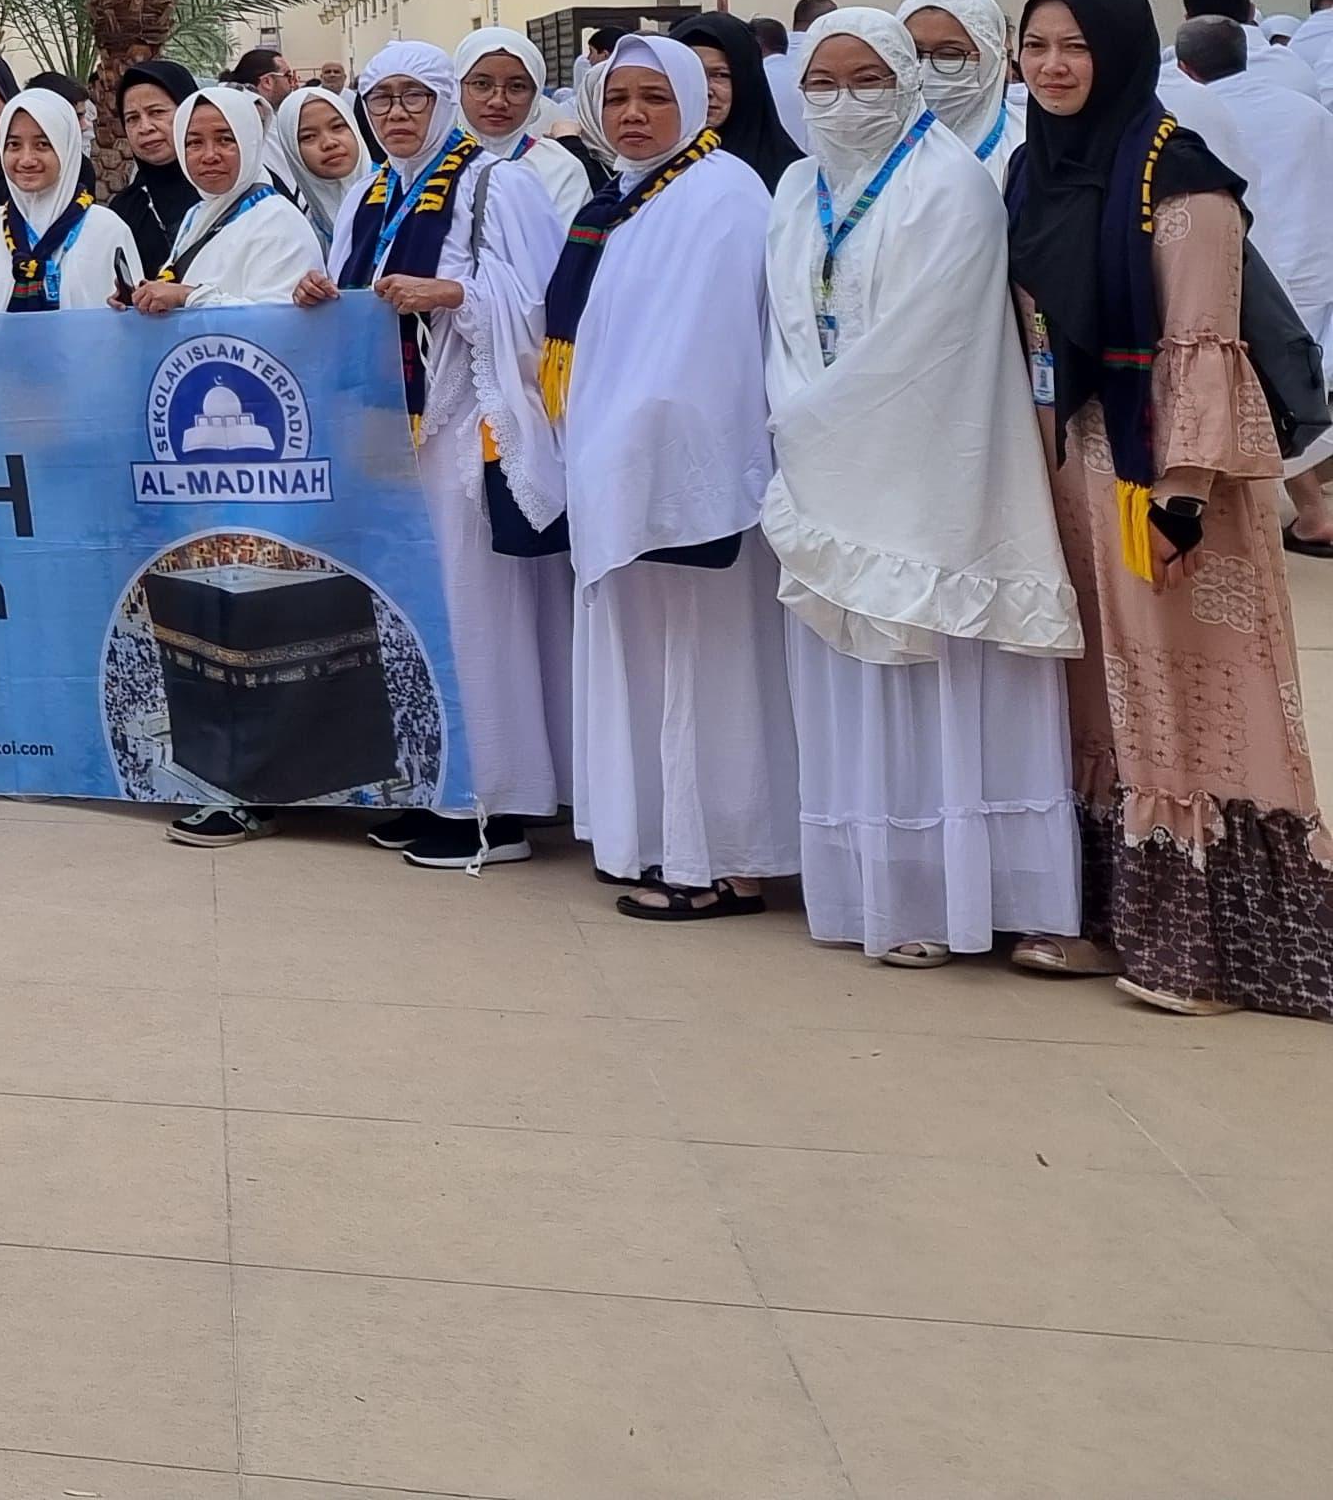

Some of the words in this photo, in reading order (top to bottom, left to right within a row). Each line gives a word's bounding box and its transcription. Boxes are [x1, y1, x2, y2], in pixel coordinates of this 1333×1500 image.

[152, 357, 187, 453] SEKOLAH
[187, 343, 244, 364] ISLAM
[253, 353, 303, 450] TERPADU
[140, 467, 325, 495] AL-MADINAH
